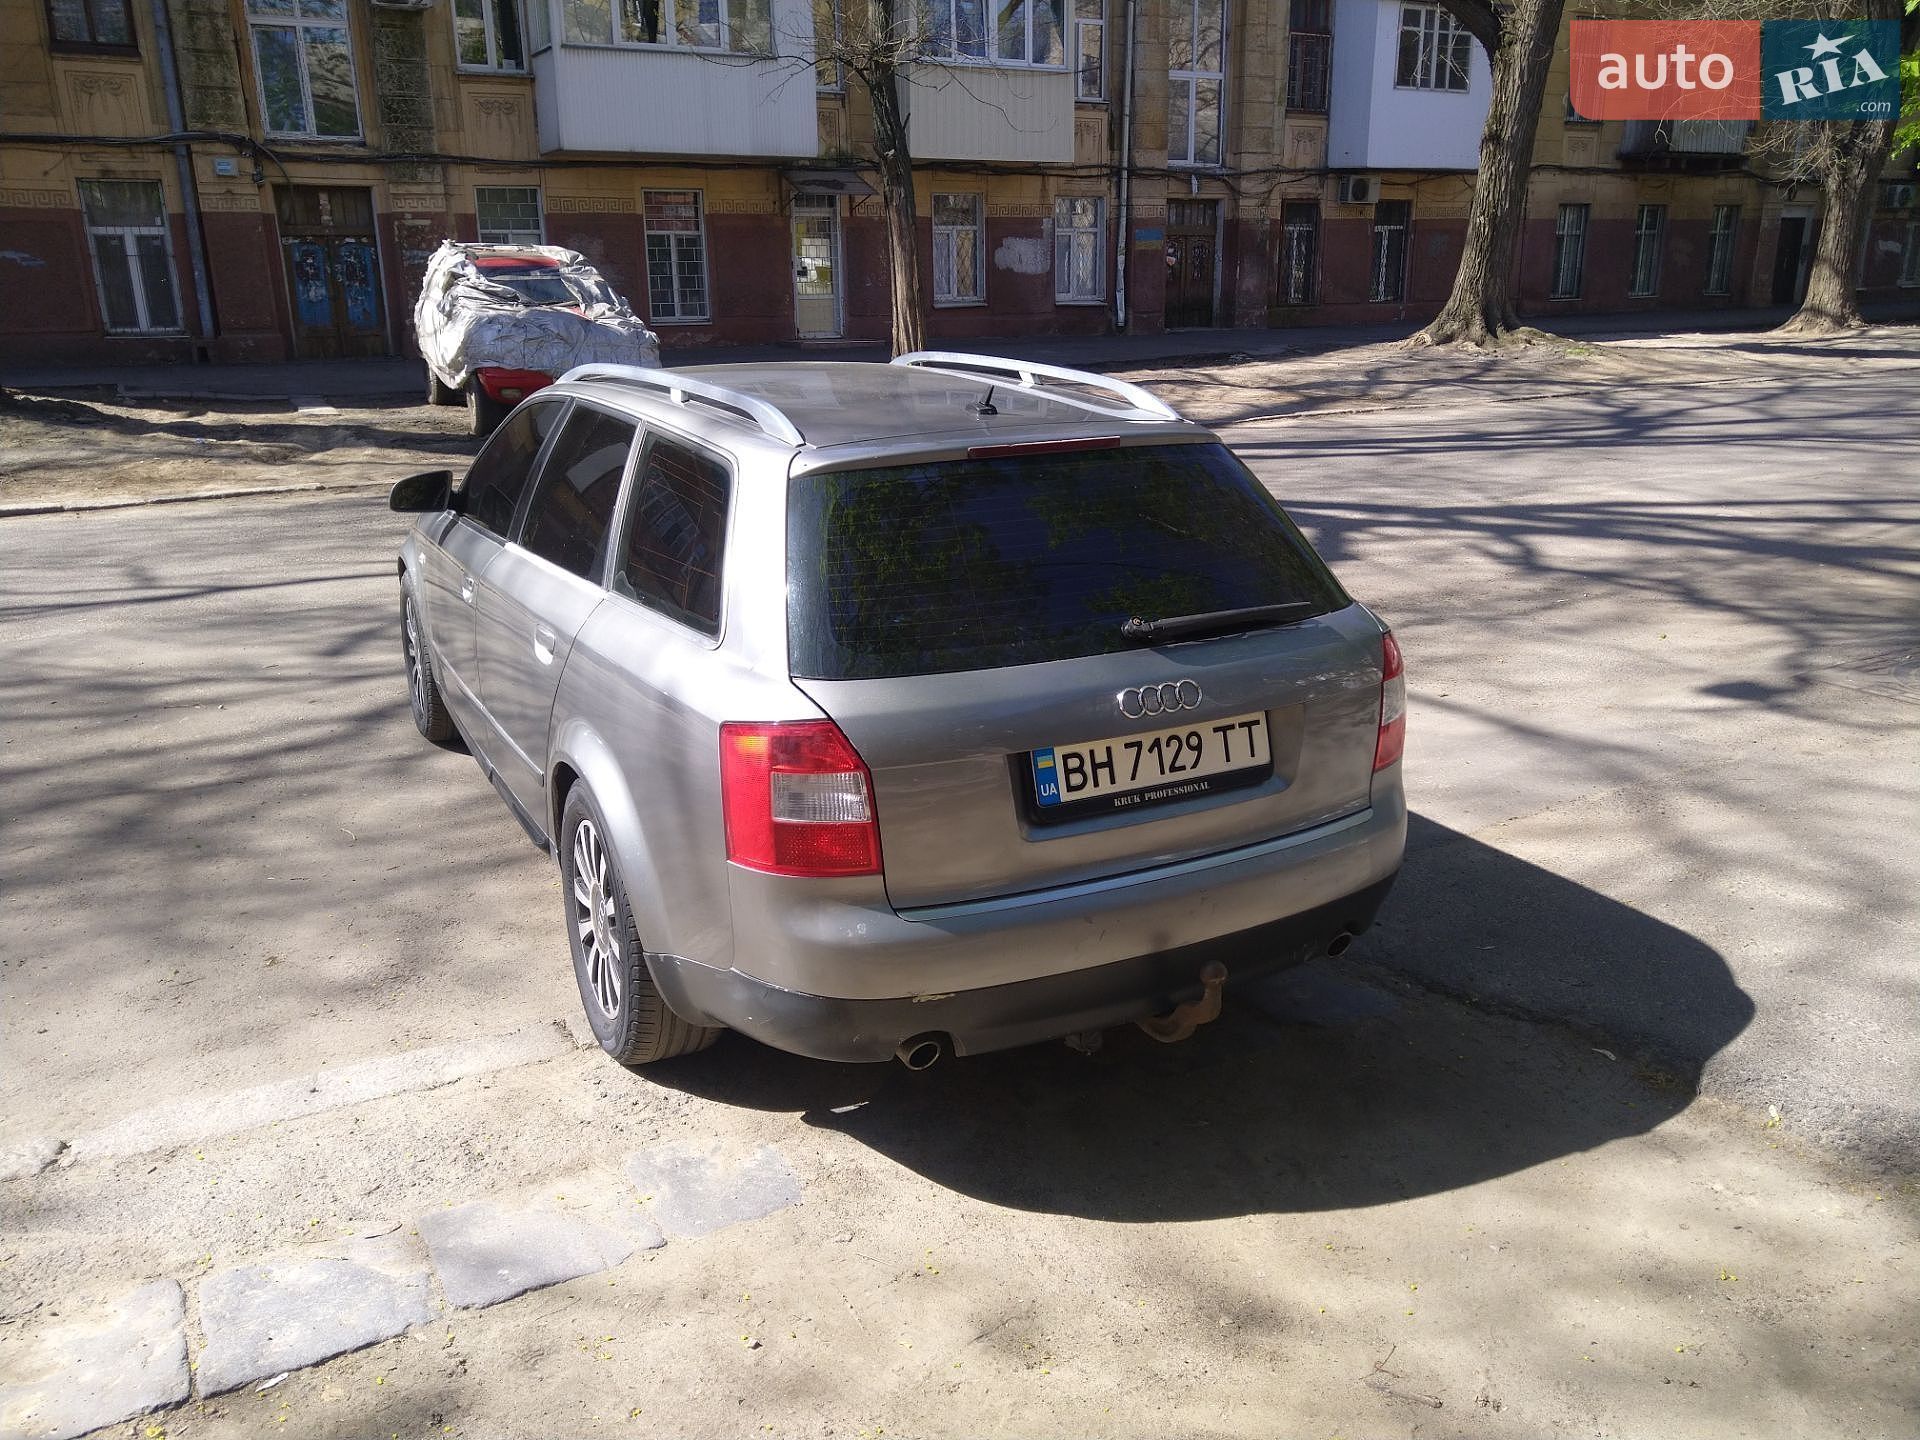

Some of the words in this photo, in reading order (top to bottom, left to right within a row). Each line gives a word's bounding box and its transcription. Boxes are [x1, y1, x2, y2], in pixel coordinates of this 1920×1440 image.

[1061, 746, 1117, 793] BH
[1123, 730, 1204, 782] 7129
[1212, 719, 1261, 763] TT
[1040, 781, 1059, 797] UA
[1113, 793, 1141, 807] KRUK
[1144, 781, 1211, 801] PROFESSIONAL
